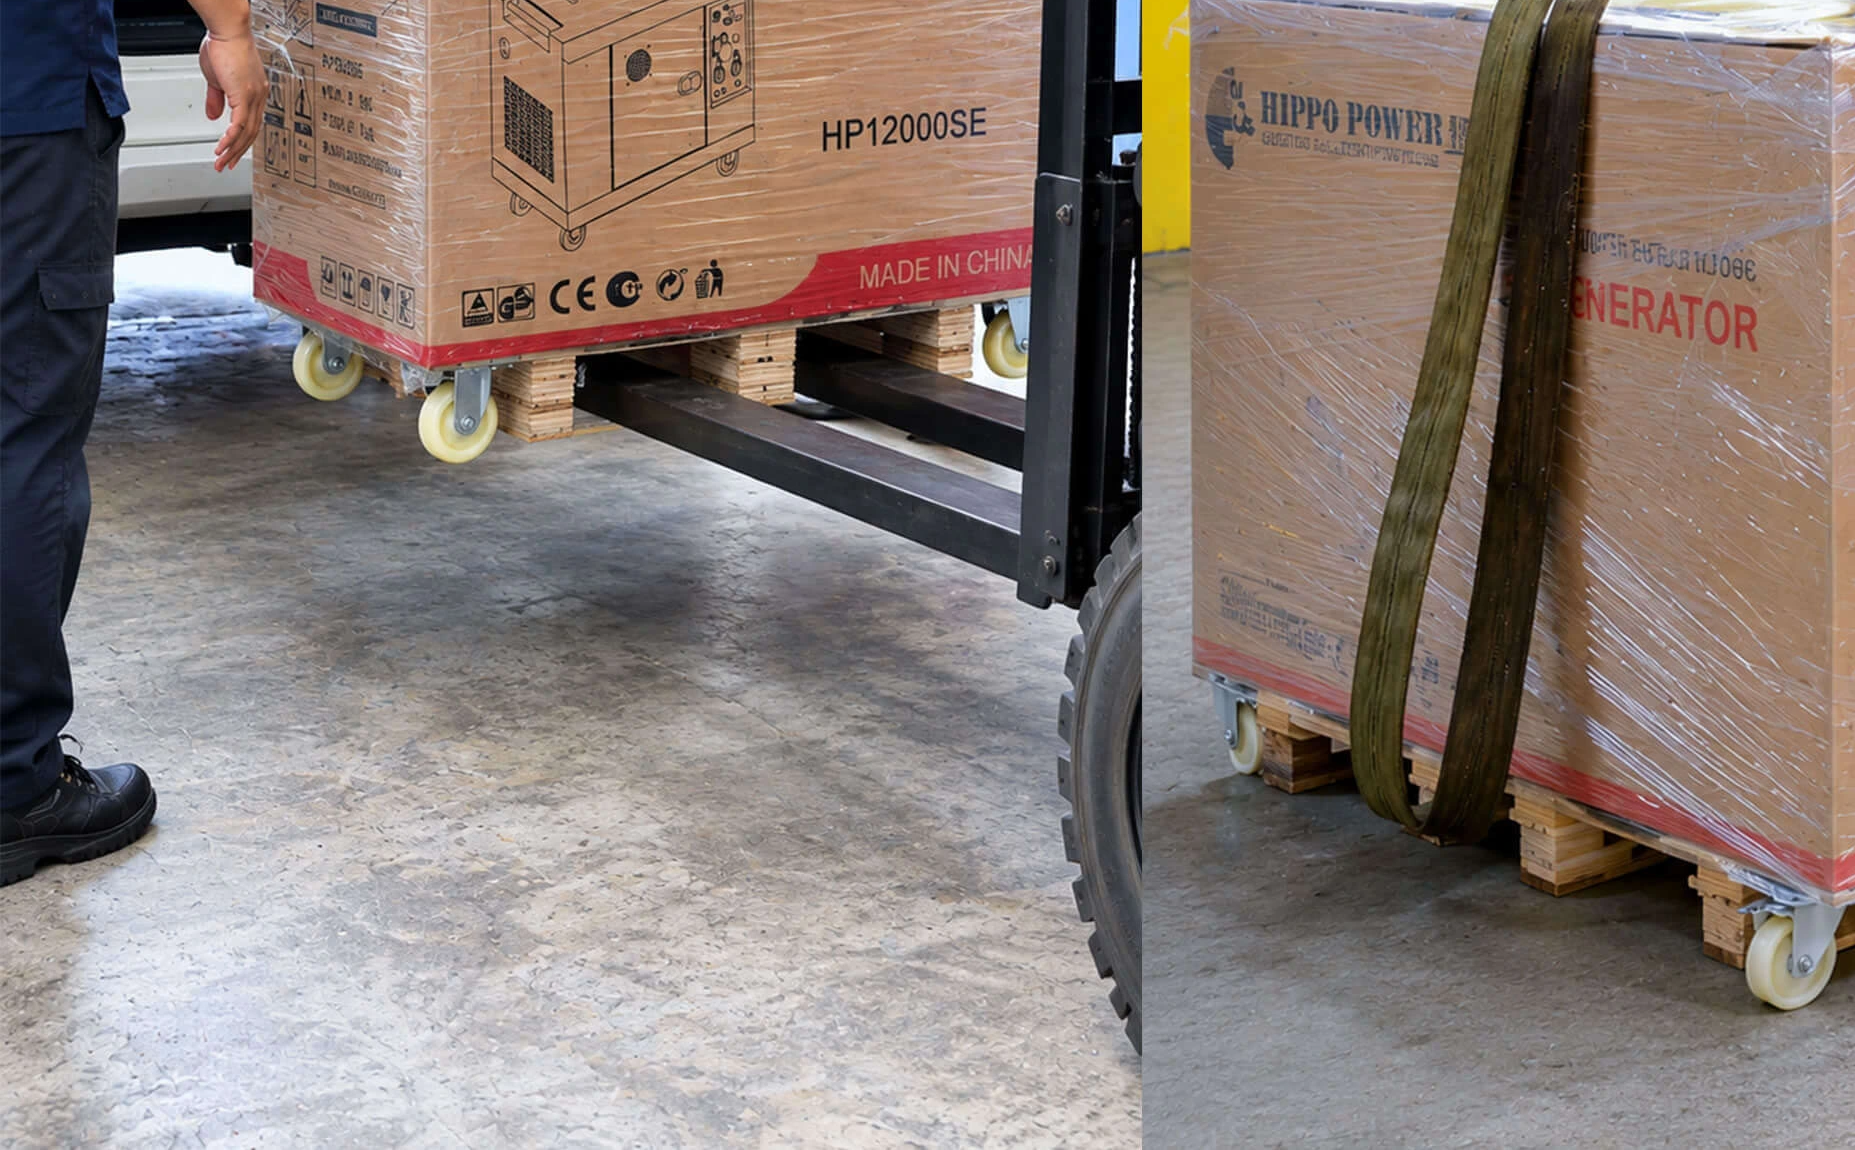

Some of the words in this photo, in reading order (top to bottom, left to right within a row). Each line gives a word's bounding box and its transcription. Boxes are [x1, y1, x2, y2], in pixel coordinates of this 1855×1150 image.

[822, 107, 987, 152] HP12000SE
[1260, 90, 1339, 134] HIPPO
[1346, 101, 1443, 146] POWER
[859, 256, 931, 290] MADE
[938, 253, 960, 280] IN
[1571, 275, 1758, 353] ENERATOR
